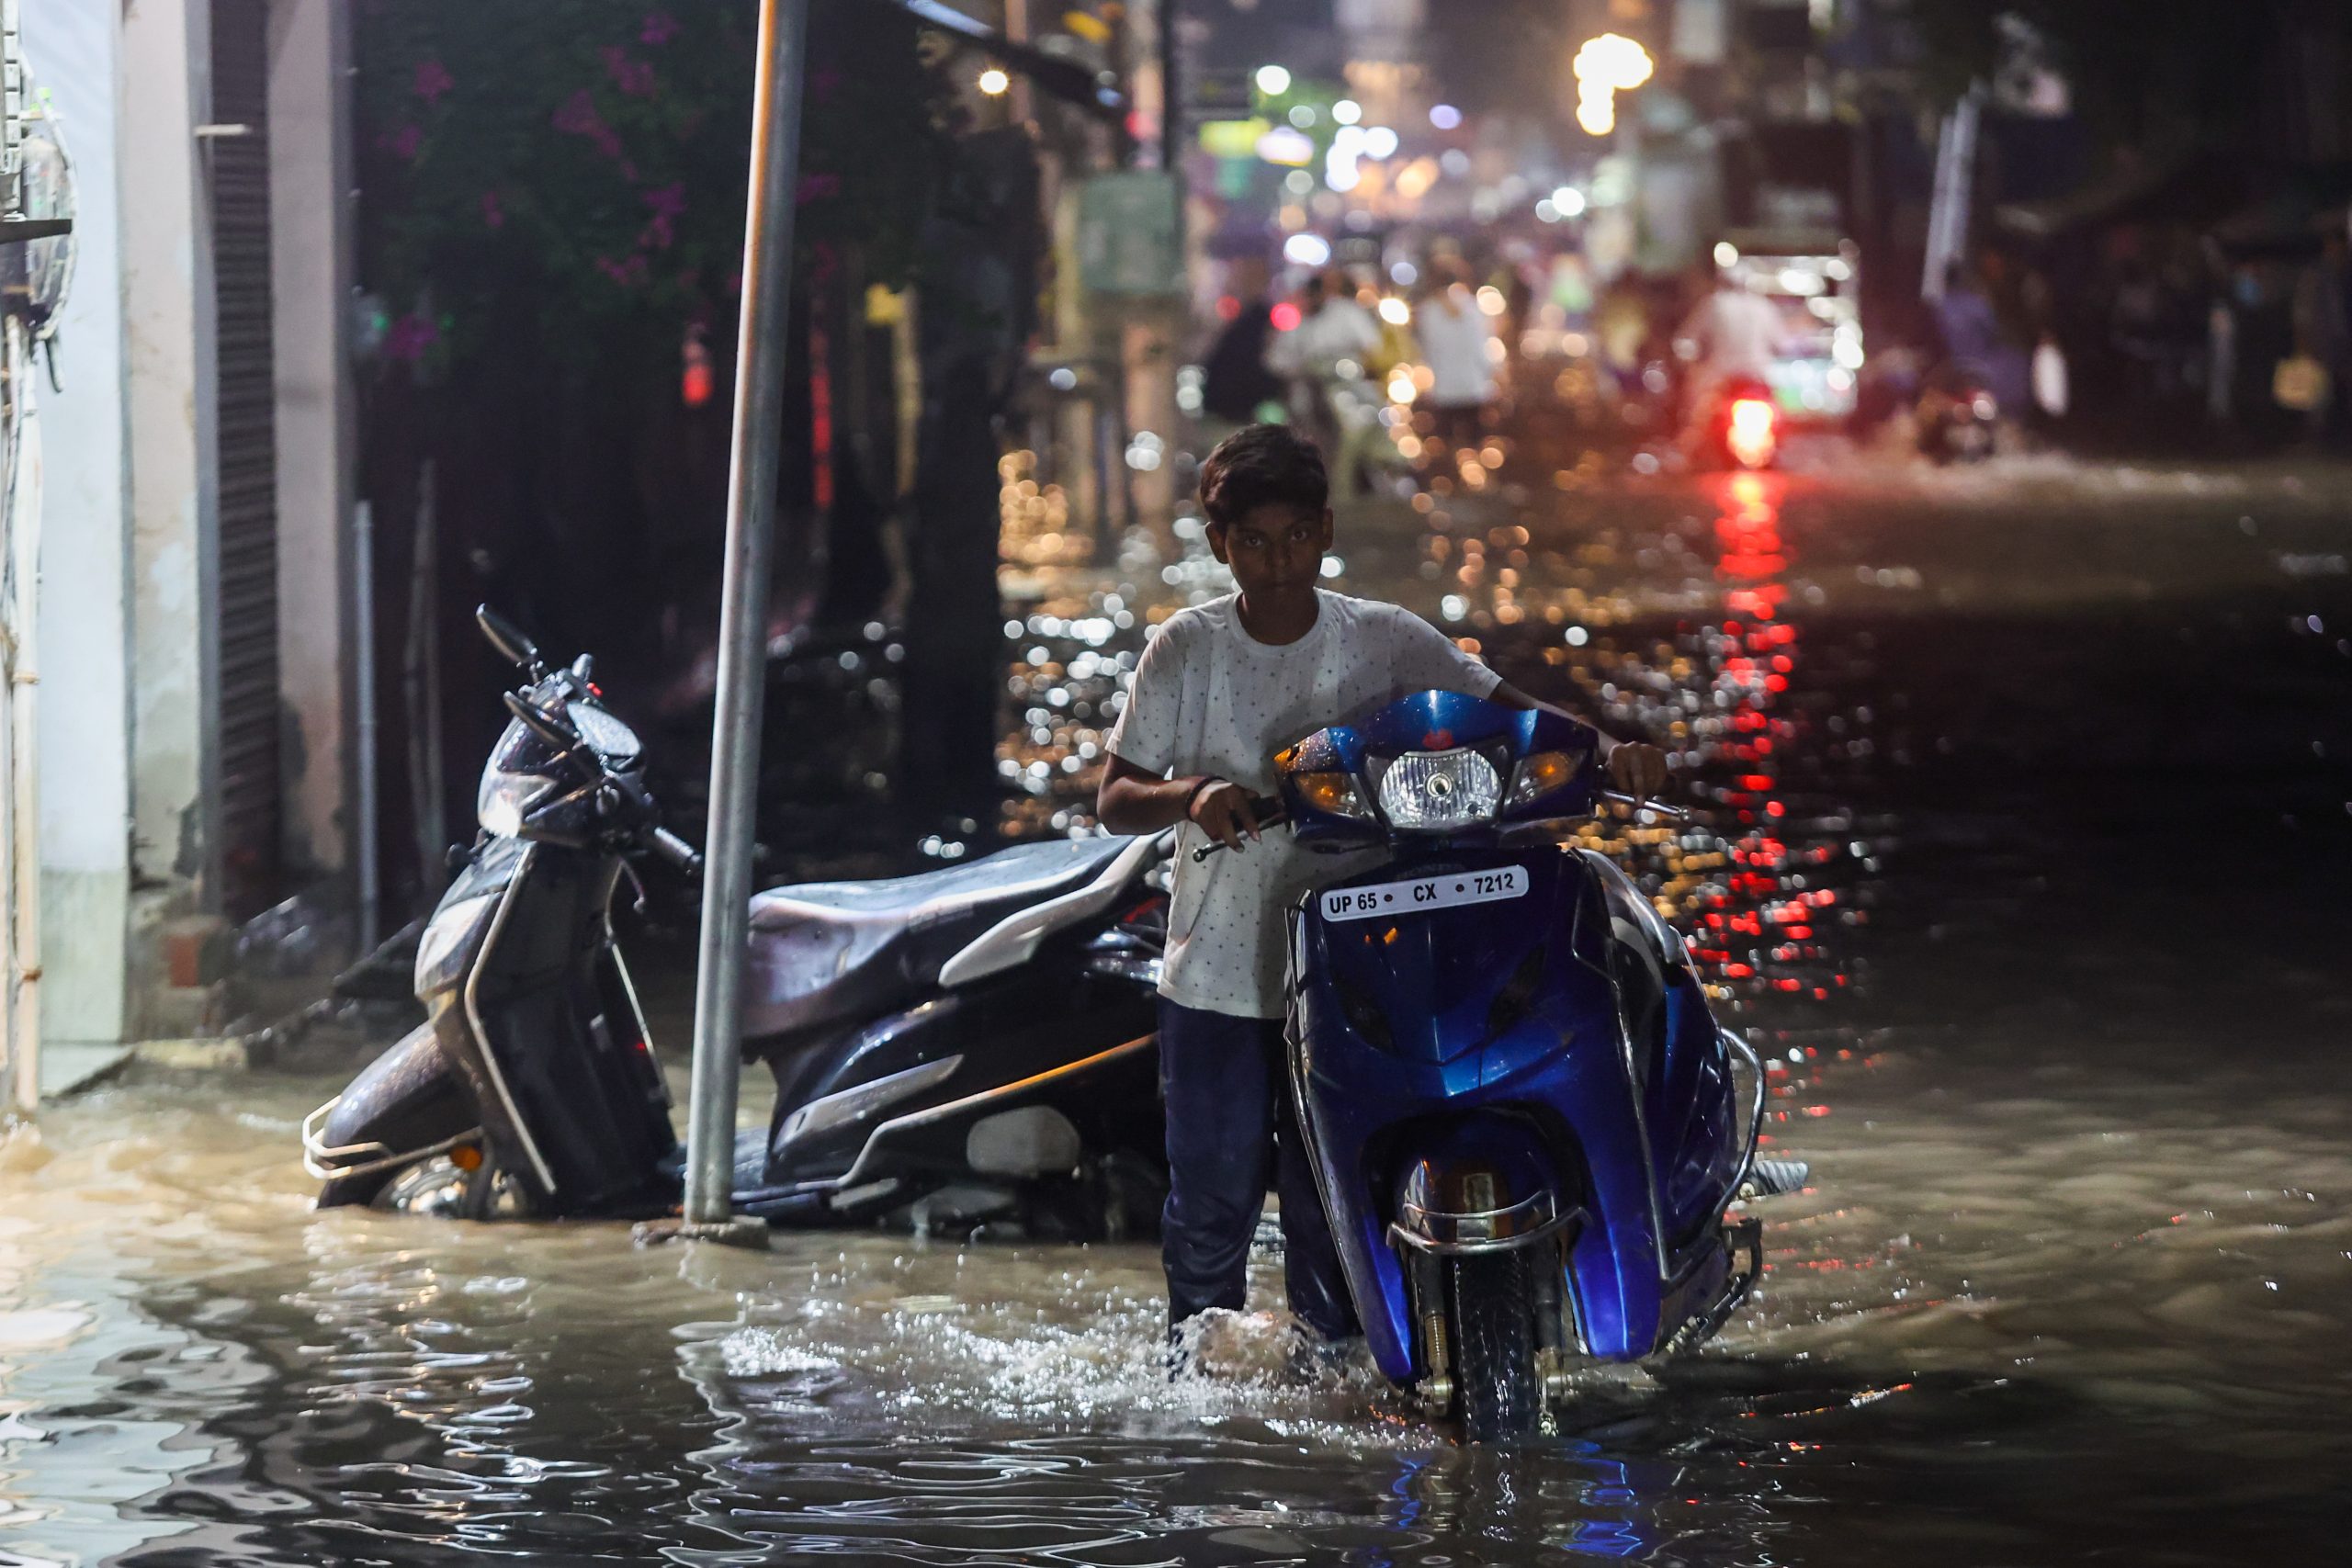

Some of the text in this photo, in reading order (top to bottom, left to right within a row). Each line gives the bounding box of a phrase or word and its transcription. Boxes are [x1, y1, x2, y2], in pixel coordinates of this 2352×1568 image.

[1329, 873, 1514, 913] UP 65 CX 7212
